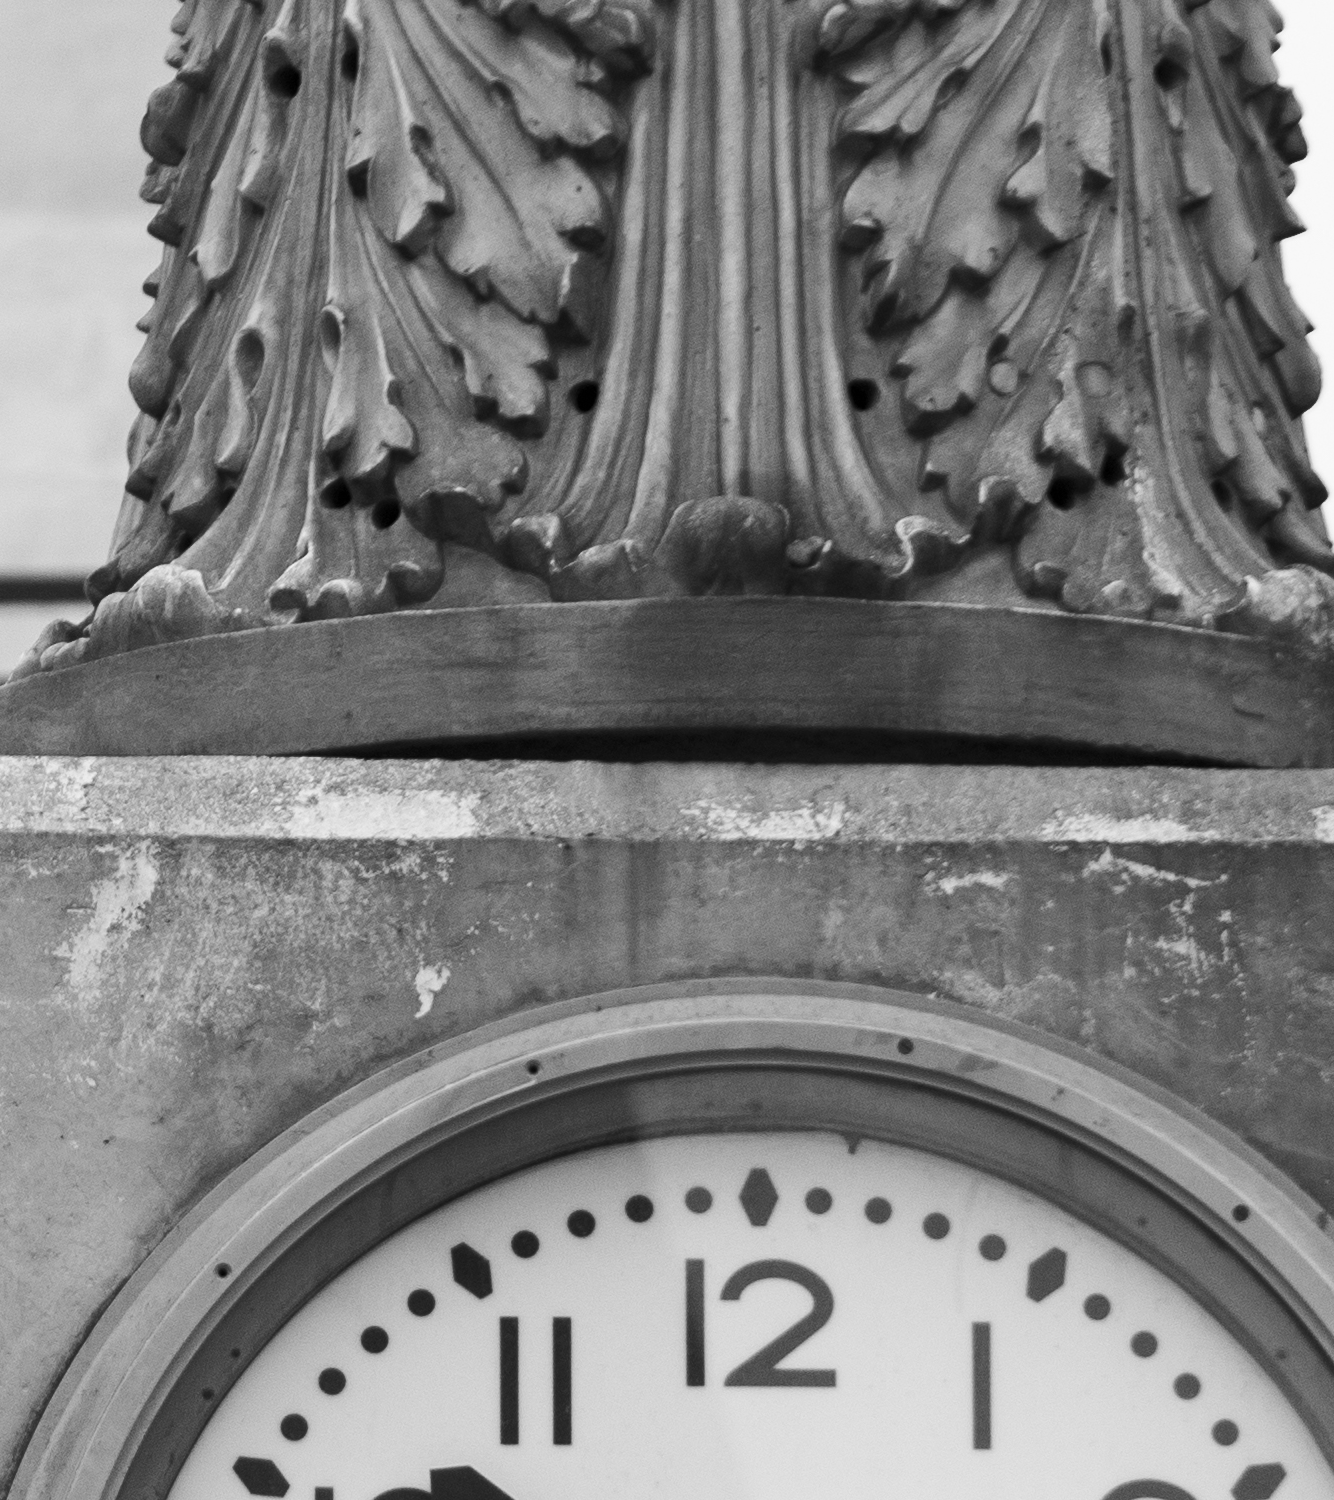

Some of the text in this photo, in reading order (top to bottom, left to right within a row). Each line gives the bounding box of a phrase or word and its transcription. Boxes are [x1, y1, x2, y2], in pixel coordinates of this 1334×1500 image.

[499, 1316, 572, 1446] 11
[685, 1258, 836, 1388] 12
[972, 1322, 992, 1450] 1
